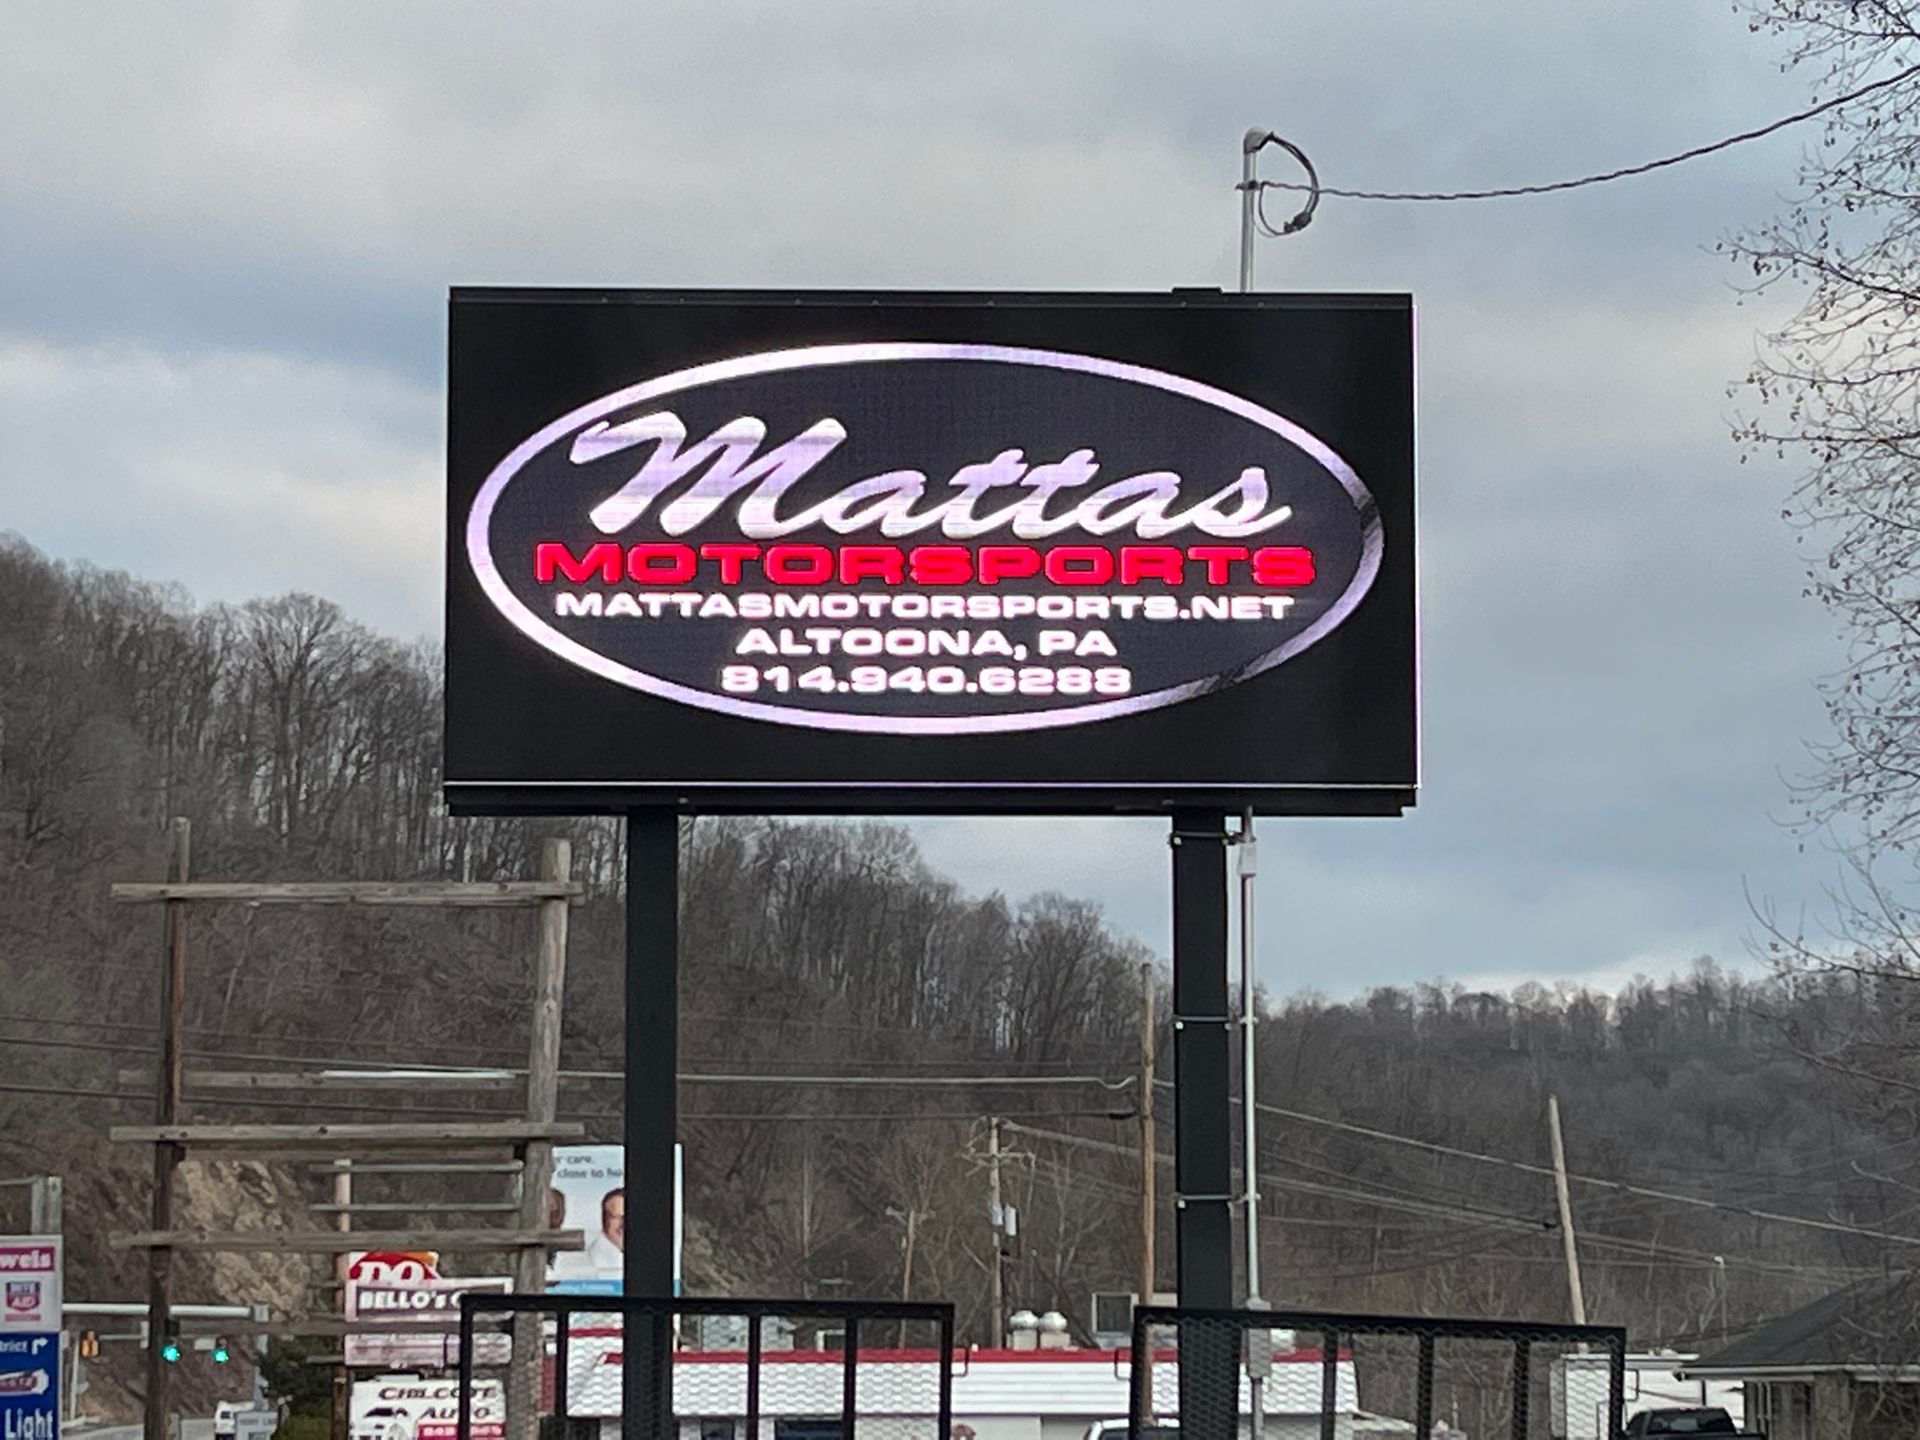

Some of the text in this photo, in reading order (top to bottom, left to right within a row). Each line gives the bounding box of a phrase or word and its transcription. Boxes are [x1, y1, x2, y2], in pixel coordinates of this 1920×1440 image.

[570, 411, 1292, 538] Mattas
[534, 543, 1316, 587] MOTORSPORTS
[556, 593, 1295, 619] MATTASMOTORSPORTS.NET
[735, 628, 1118, 661] ALTOONA, PA
[721, 665, 1131, 693] 814.940.6288
[5, 1407, 54, 1440] Light
